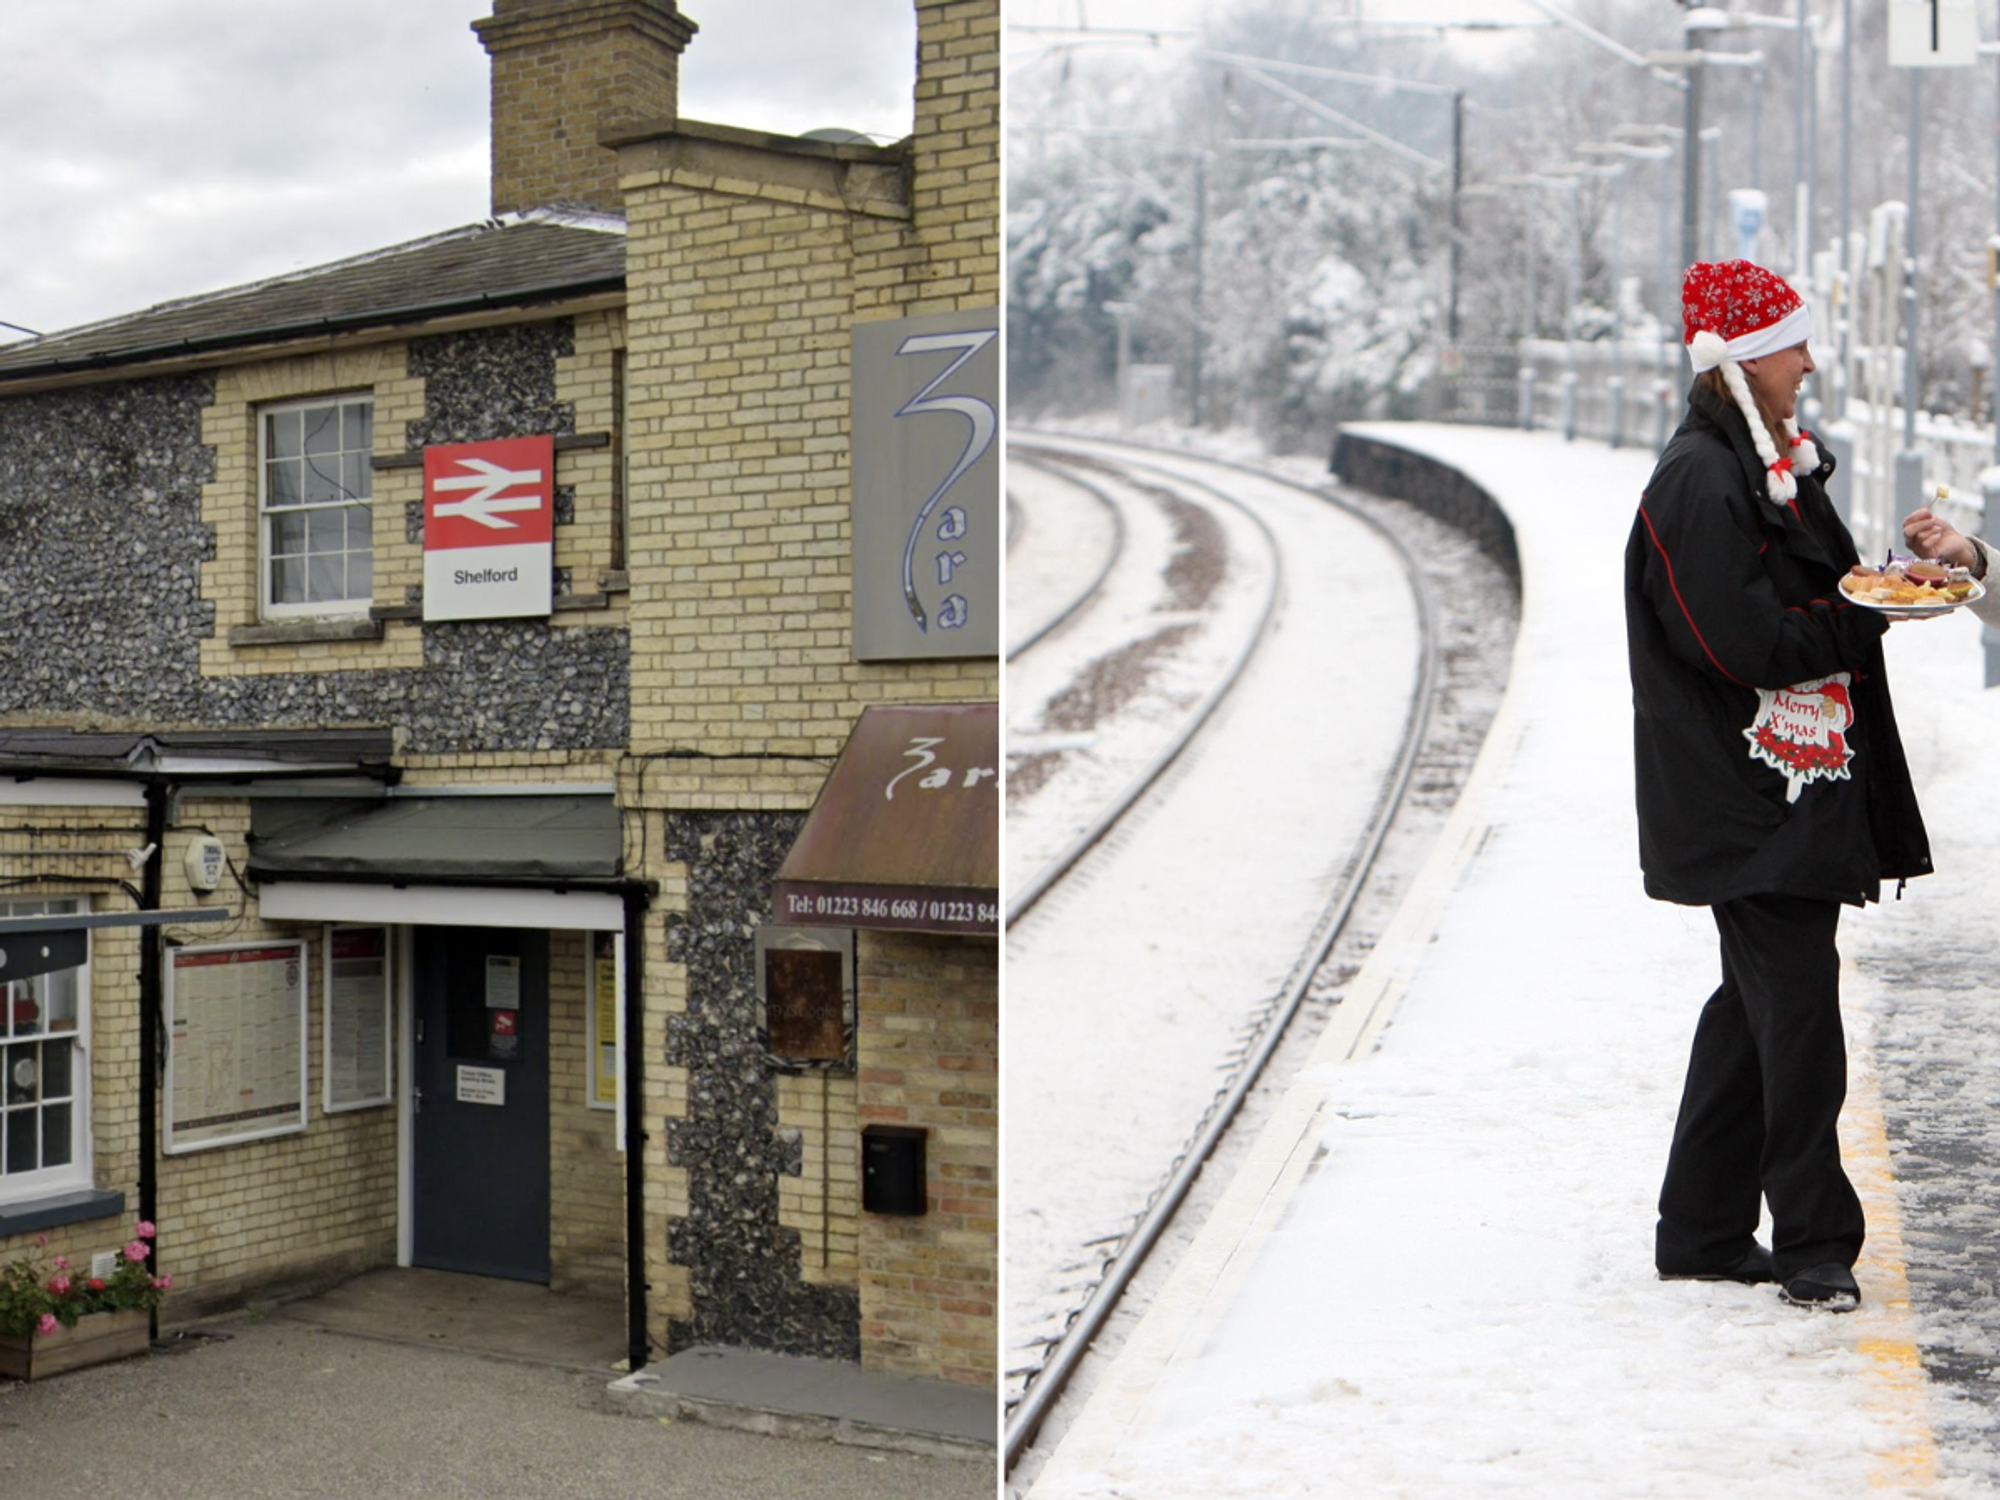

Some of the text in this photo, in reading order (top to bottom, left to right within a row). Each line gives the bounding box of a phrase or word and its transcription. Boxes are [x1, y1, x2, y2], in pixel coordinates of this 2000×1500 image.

[454, 567, 518, 584] Shelford
[1773, 690, 1821, 721] Merry
[1769, 711, 1817, 737] X'mas
[885, 737, 999, 801] Zar
[787, 894, 813, 914] Tel:
[816, 896, 858, 916] 01223
[862, 898, 888, 917] 846
[891, 900, 918, 919] 668
[920, 900, 926, 919] /
[930, 901, 973, 921] 01223
